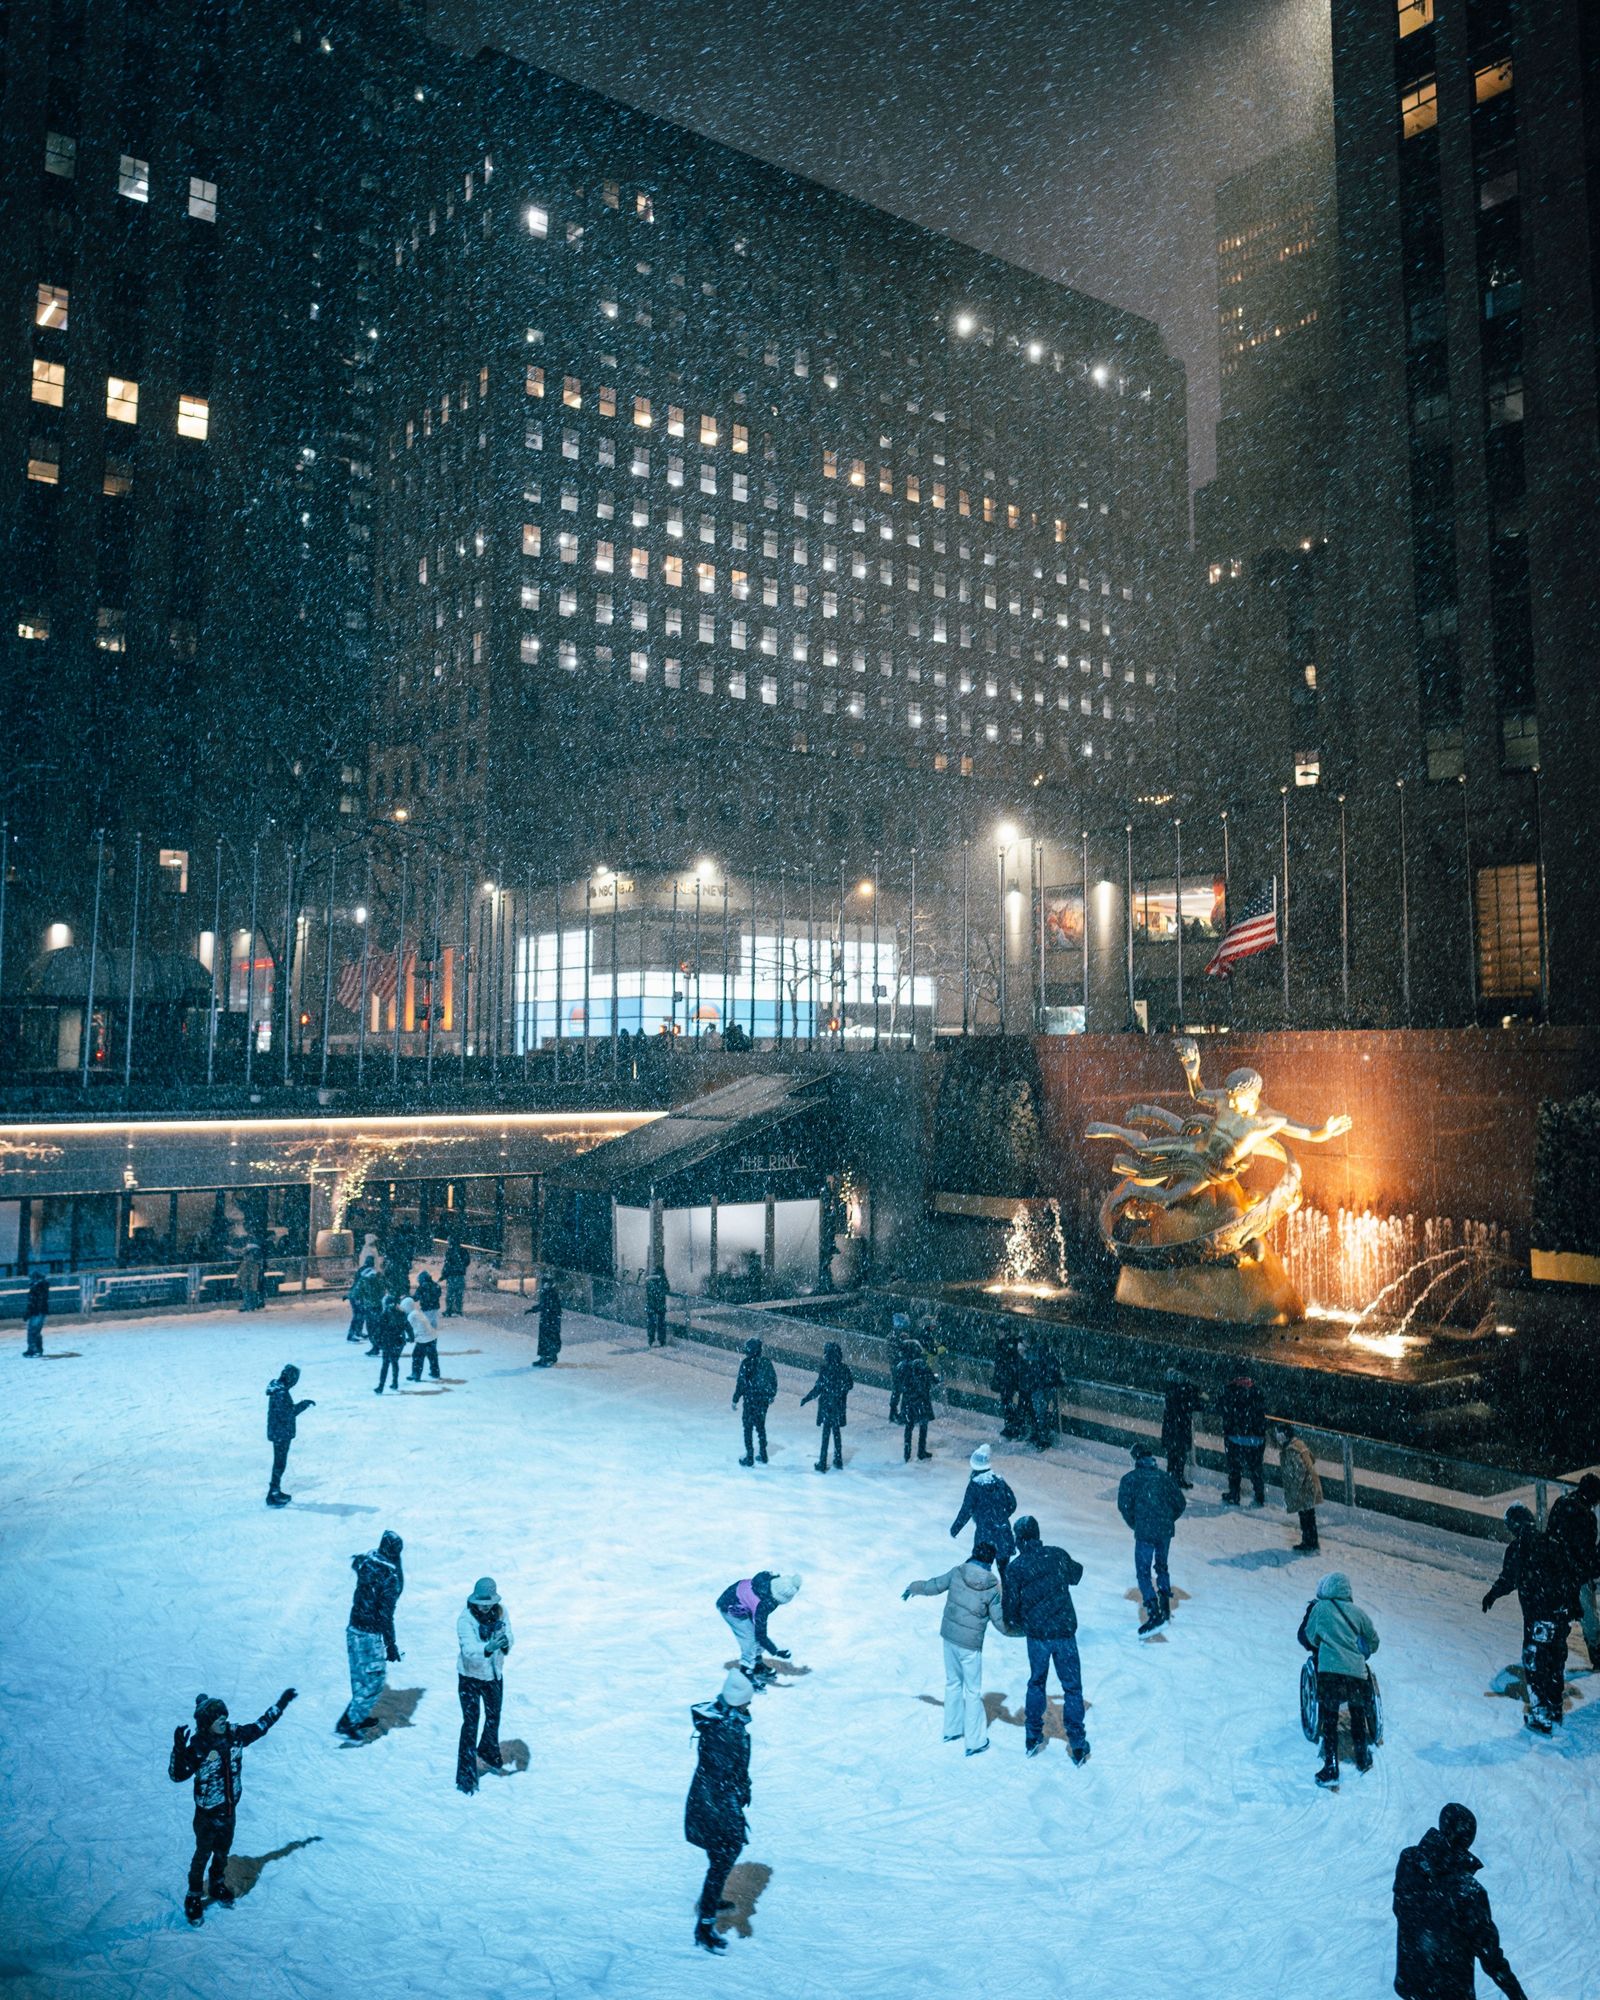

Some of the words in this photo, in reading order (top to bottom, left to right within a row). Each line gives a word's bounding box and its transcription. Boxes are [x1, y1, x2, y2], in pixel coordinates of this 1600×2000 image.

[598, 884, 613, 897] NBC
[740, 1155, 764, 1170] THE
[768, 1152, 800, 1169] RINK
